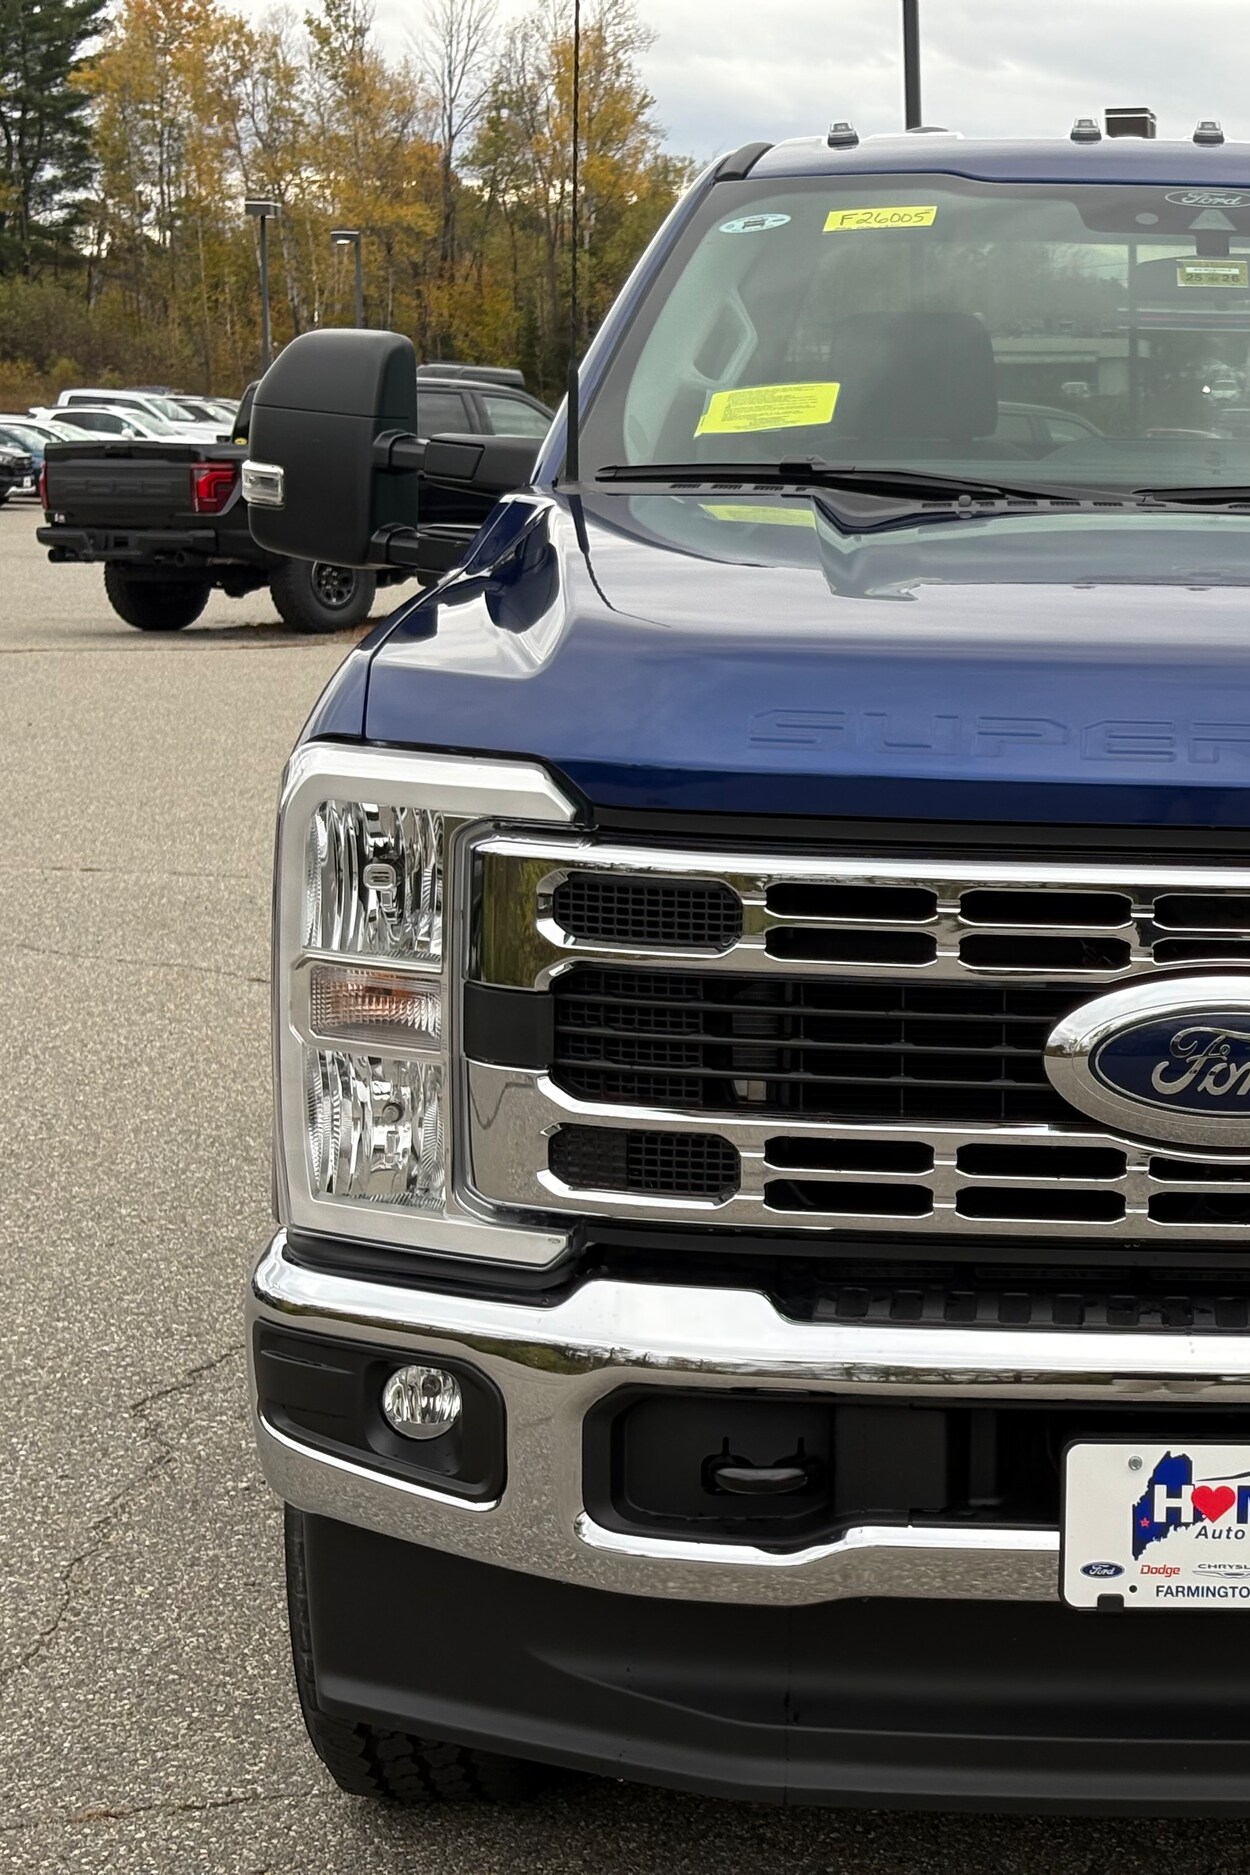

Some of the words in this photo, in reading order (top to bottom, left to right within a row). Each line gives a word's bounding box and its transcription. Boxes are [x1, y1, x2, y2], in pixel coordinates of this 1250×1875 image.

[1181, 191, 1243, 206] Ford
[839, 211, 931, 227] F26005
[1194, 1525, 1246, 1541] Auto
[1139, 1564, 1181, 1578] Dodge
